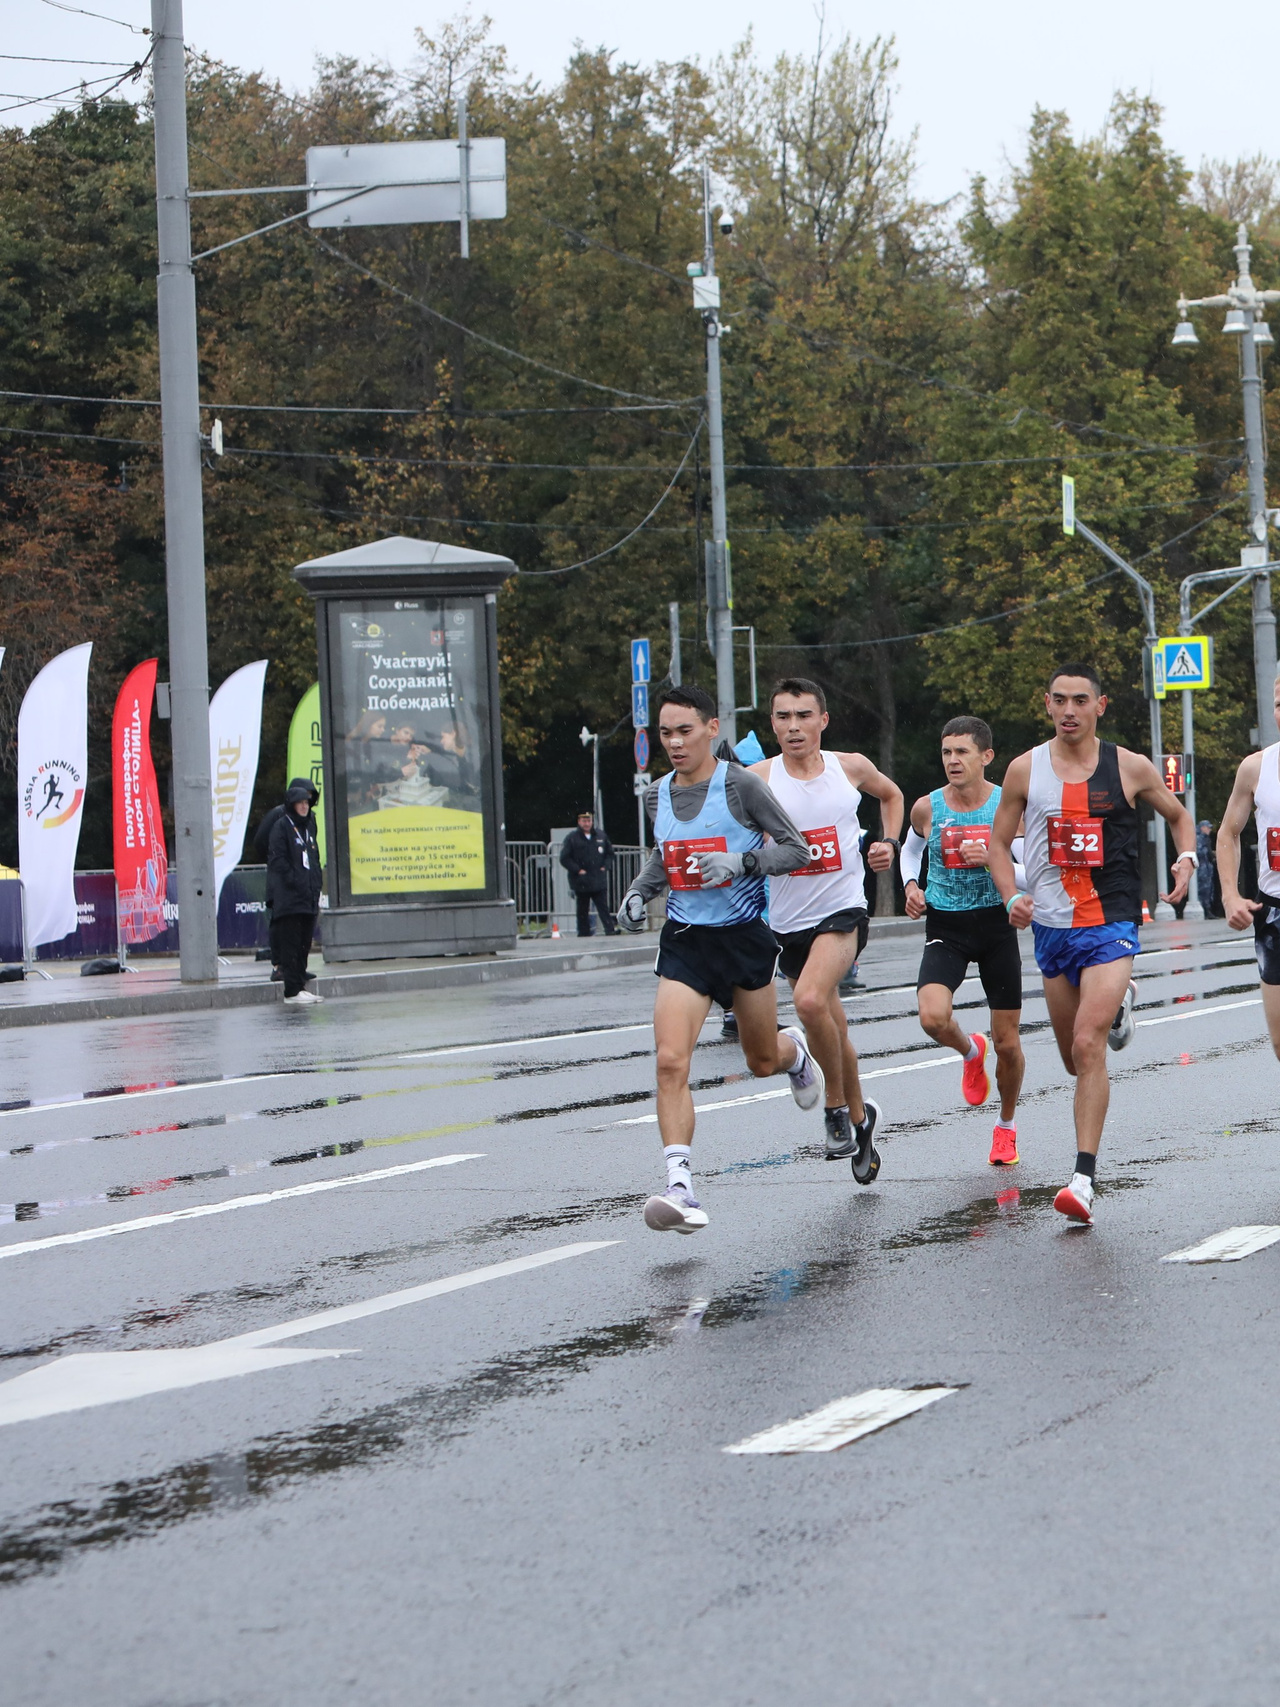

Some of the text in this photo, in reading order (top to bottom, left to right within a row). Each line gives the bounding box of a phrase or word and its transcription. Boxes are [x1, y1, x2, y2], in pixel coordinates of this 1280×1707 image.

[371, 652, 452, 671] Участвуй!
[368, 672, 453, 692] Сохраняй!
[367, 693, 455, 711] Побеждай!
[131, 699, 146, 847] «МОЯ СТОЛИЦА»
[24, 759, 80, 817] RUSSIA RUNNING
[123, 727, 135, 848] Полумарафон
[1165, 774, 1184, 792] 31
[380, 845, 408, 853] Заявки
[422, 844, 456, 854] участие
[808, 840, 836, 861] 03
[1070, 833, 1099, 852] 32
[355, 855, 412, 864] принимаются
[440, 851, 480, 860] сентября.
[685, 856, 700, 875] 2
[370, 871, 467, 881] www.forumnasledie.ru
[381, 863, 443, 872] Регистрируйся
